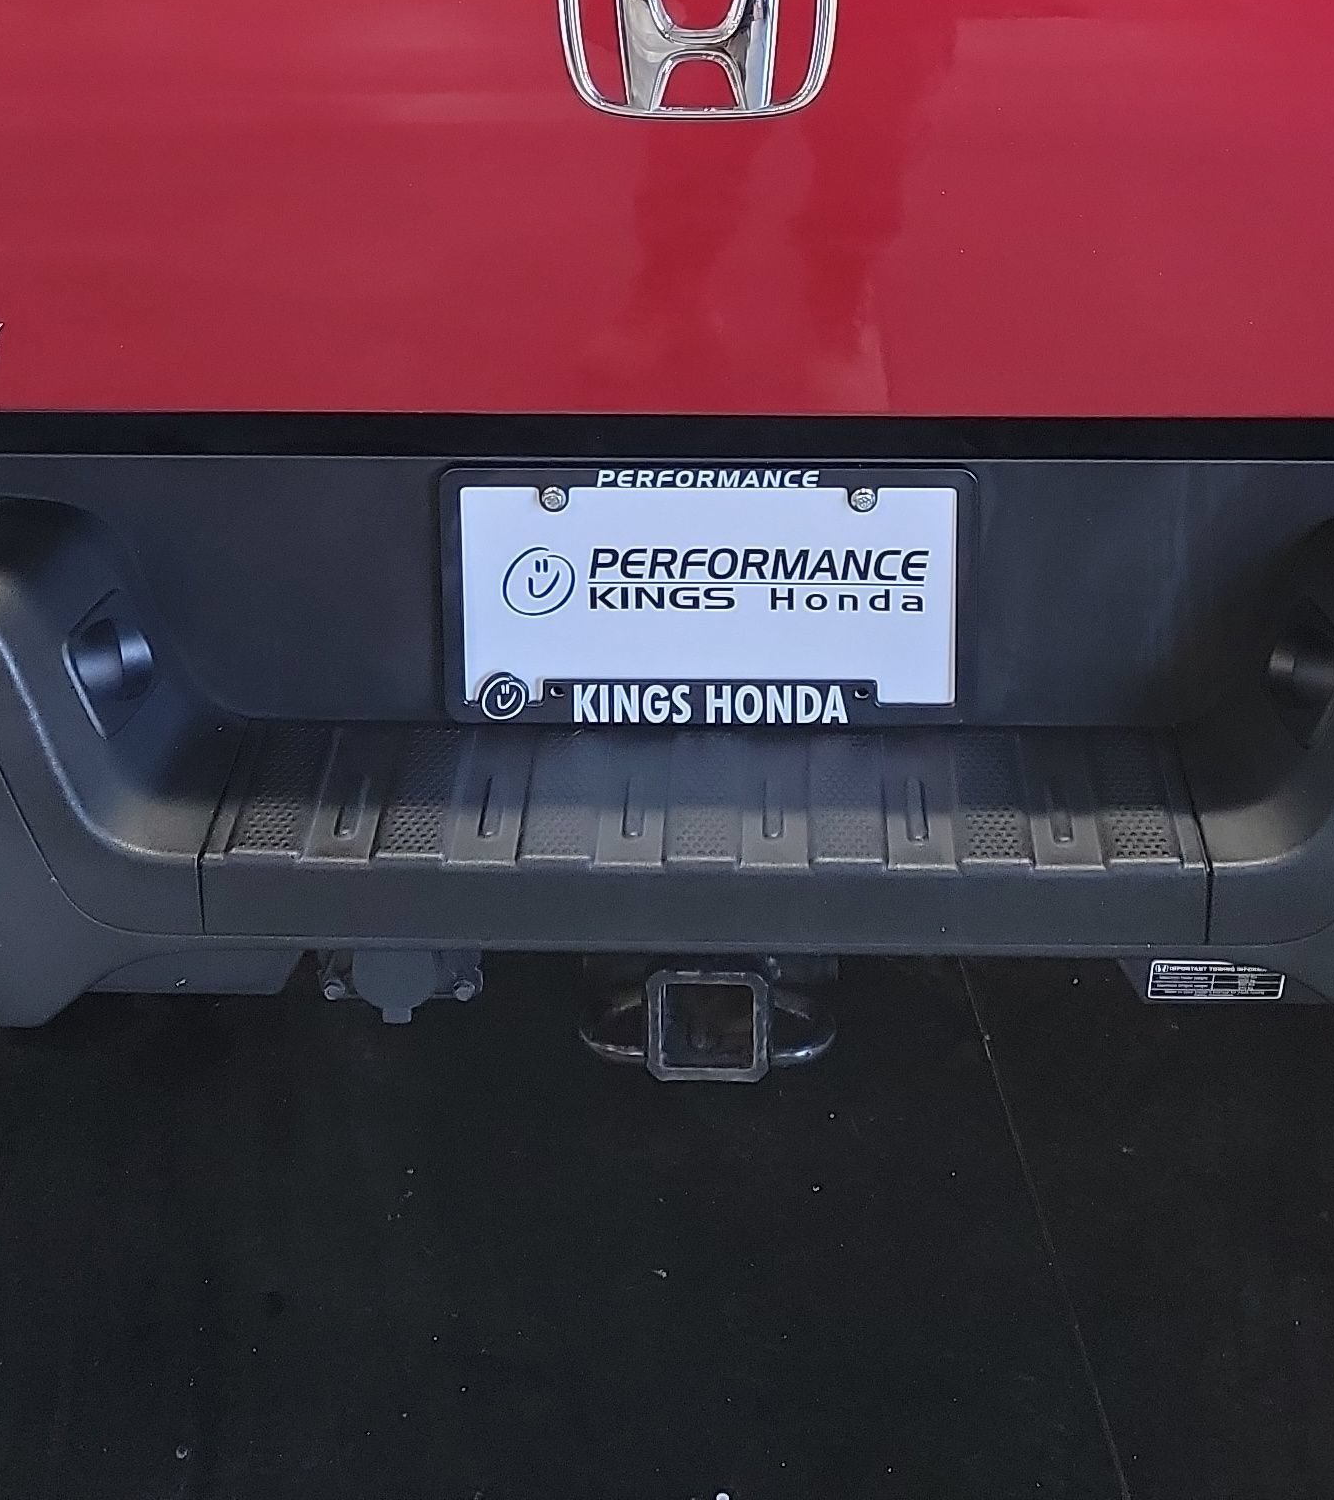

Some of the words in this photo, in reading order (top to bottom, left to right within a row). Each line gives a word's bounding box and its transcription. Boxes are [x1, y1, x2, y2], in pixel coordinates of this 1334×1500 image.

[596, 469, 820, 488] PERFORMANCE
[589, 547, 930, 581] PERFORMANCE
[588, 586, 736, 611] KINGS
[769, 587, 924, 612] Honda
[572, 685, 693, 724] KINGS
[706, 685, 849, 724] HONDA
